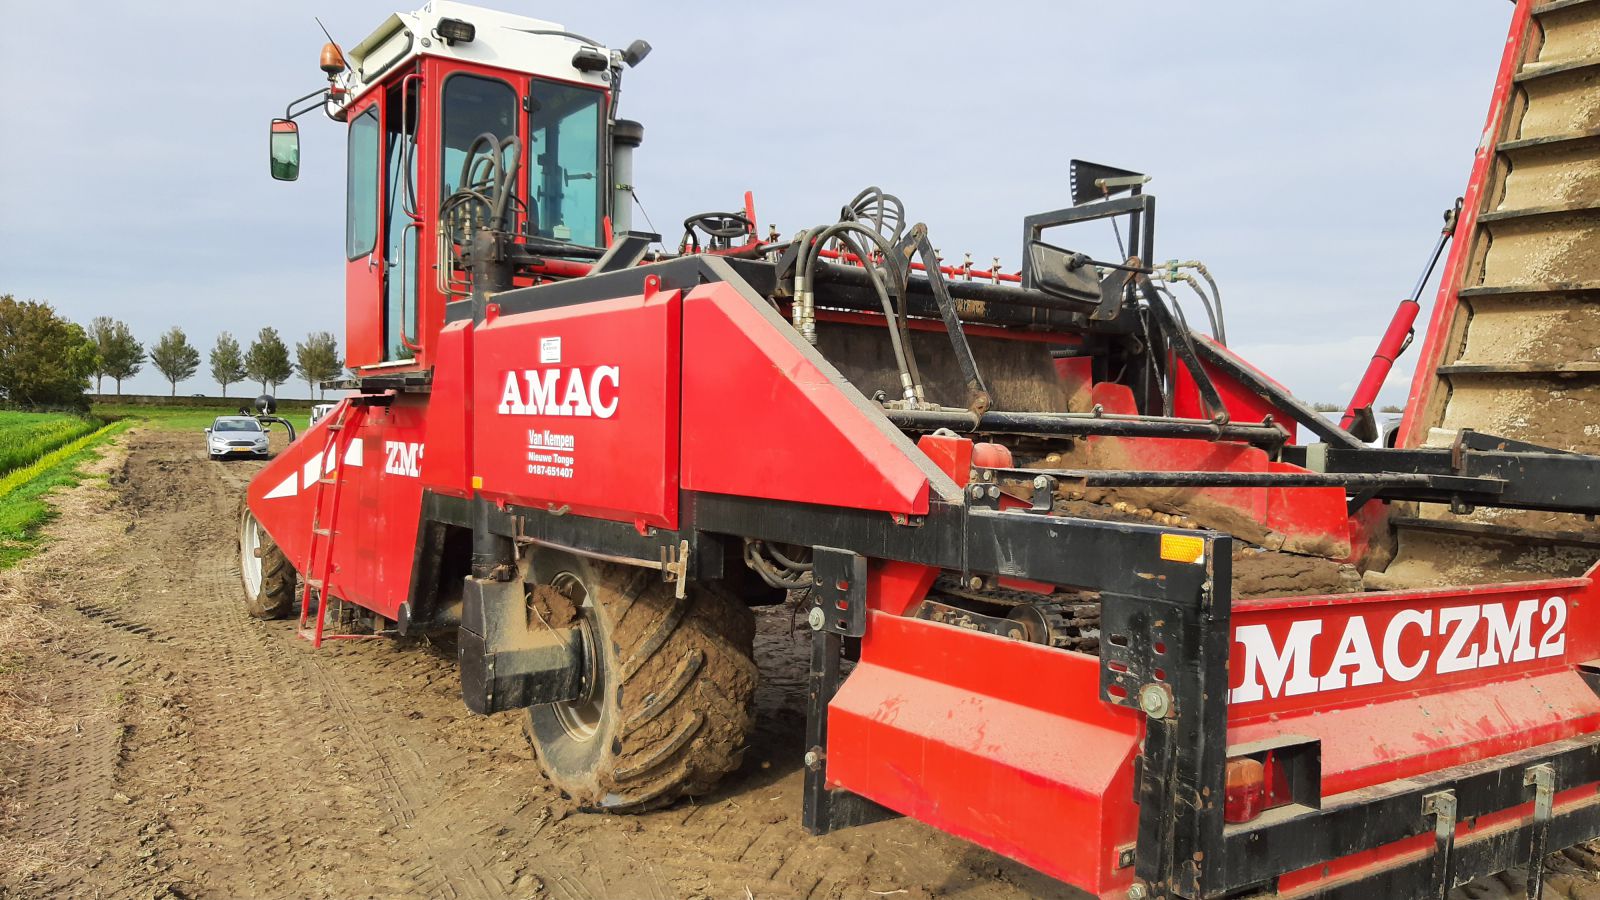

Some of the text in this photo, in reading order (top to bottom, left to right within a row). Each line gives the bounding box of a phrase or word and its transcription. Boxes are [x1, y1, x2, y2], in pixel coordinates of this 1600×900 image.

[498, 366, 619, 418] AMAC
[528, 429, 575, 450] Van Kempen
[528, 451, 574, 467] Nieuwe Tonge
[528, 464, 574, 479] 0187-651407
[1228, 596, 1567, 705] MACZM2
